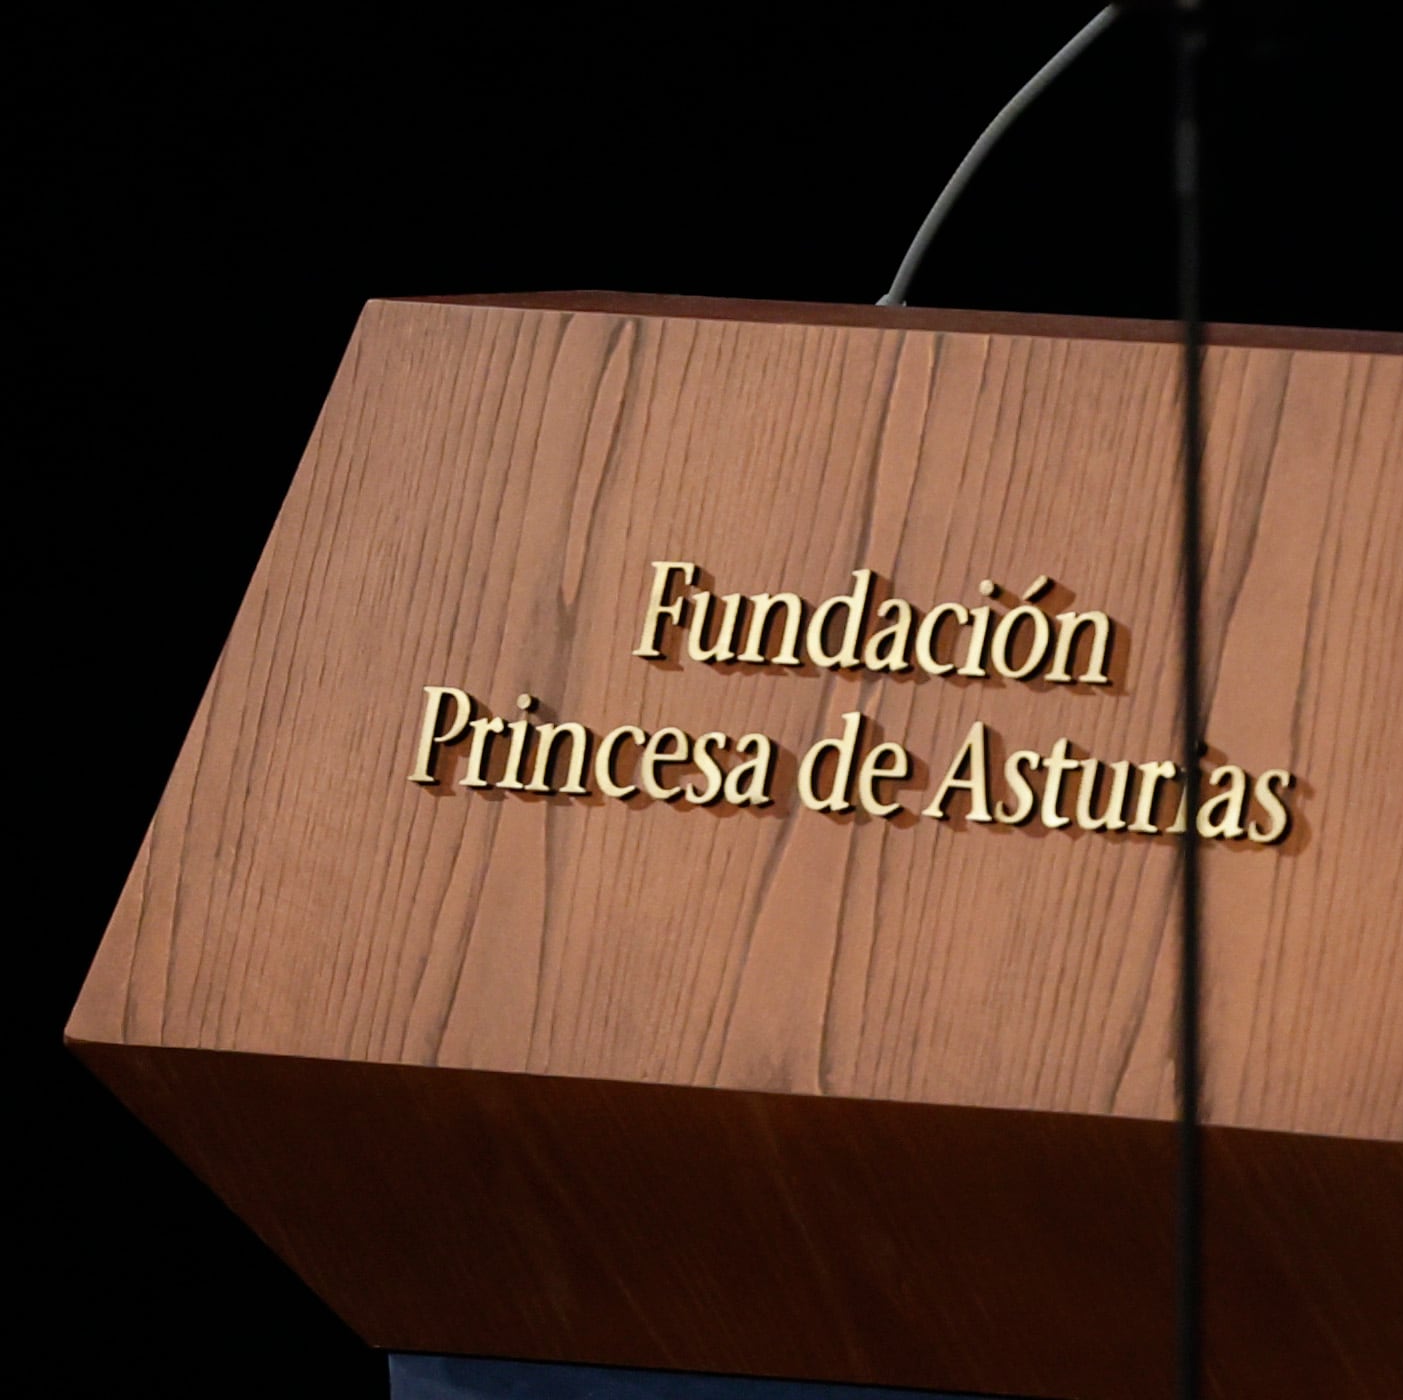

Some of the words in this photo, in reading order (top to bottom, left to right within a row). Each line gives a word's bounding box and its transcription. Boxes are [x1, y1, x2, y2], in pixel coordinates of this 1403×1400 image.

[631, 560, 1110, 683] Fundación
[406, 686, 771, 805] Princesa
[798, 711, 908, 816] de
